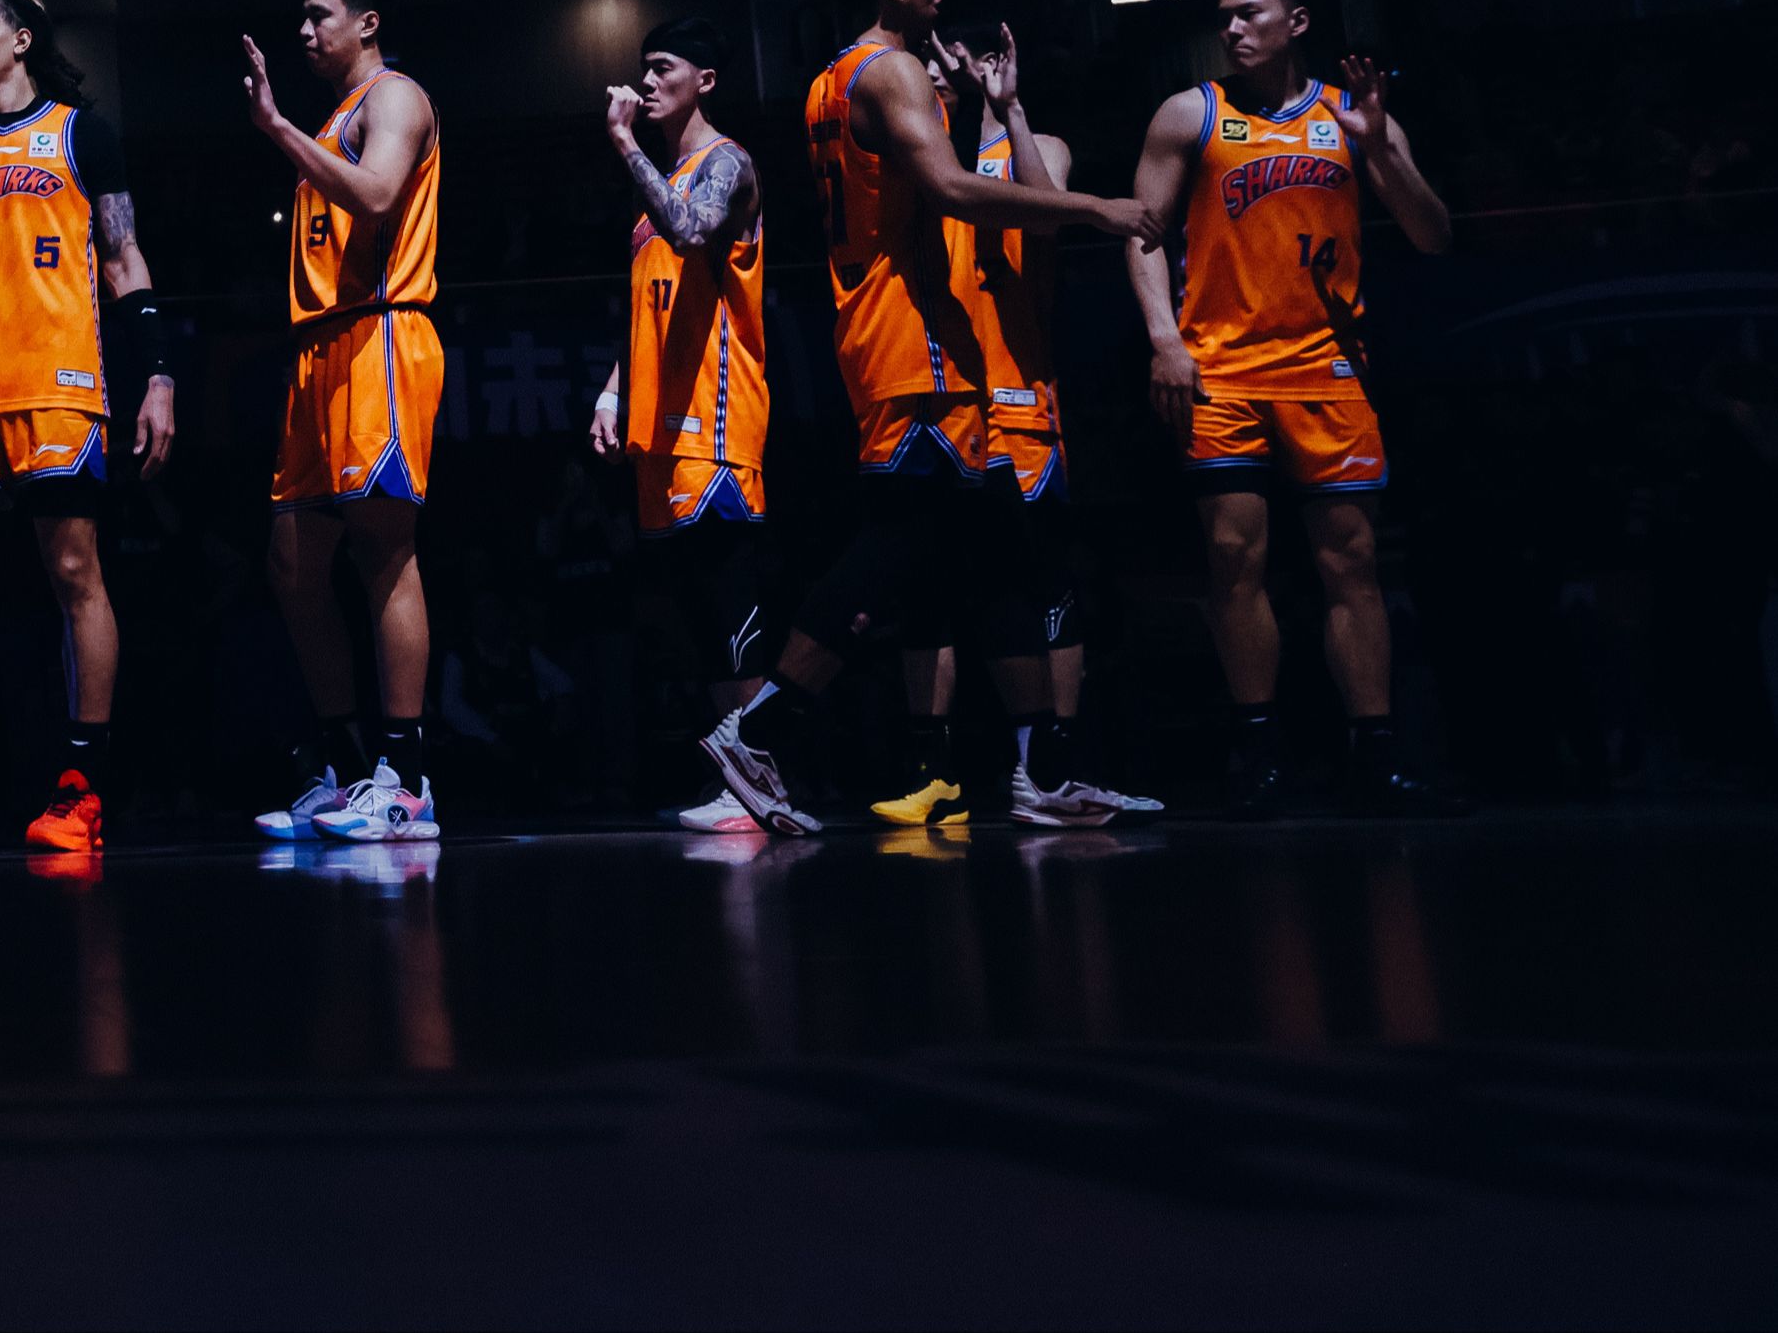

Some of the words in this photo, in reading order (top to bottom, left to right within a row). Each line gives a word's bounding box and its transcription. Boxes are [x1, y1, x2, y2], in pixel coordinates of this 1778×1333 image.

[1221, 154, 1352, 220] SHARKS
[309, 215, 329, 249] 9
[34, 235, 61, 269] 5
[1297, 233, 1338, 273] 14
[651, 278, 673, 312] 11
